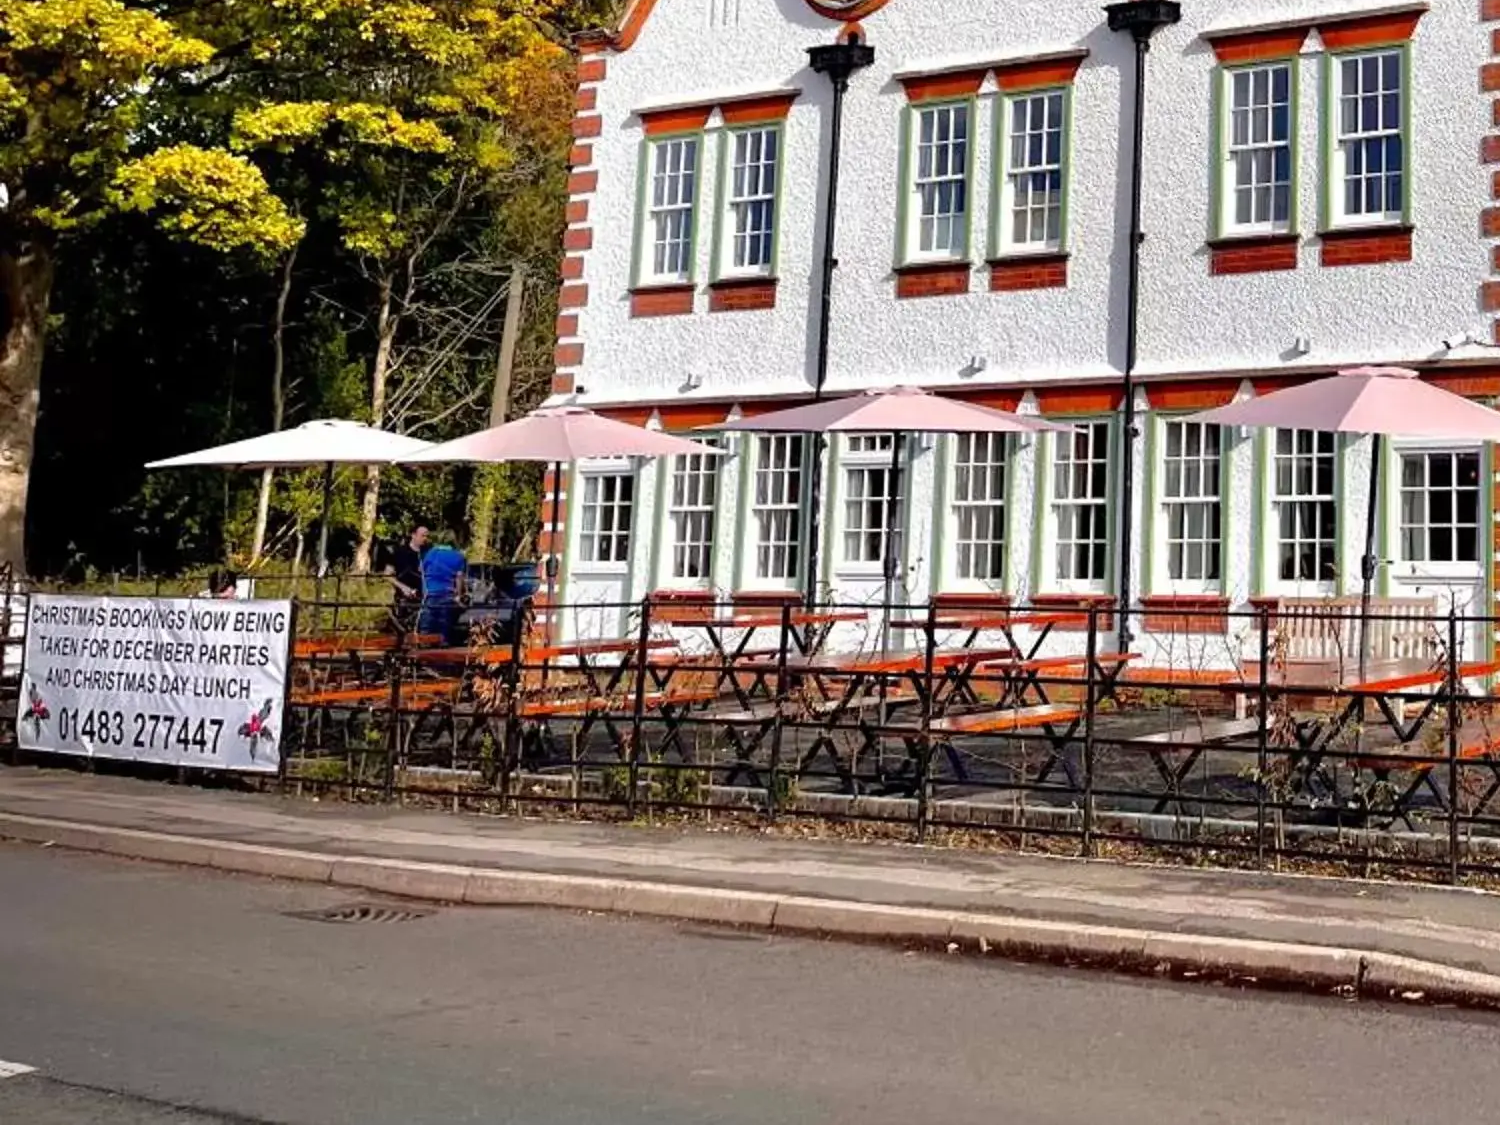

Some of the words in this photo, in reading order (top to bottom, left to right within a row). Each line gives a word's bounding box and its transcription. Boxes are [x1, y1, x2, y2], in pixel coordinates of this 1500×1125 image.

[32, 605, 105, 626] CHRISTMAS
[110, 608, 186, 630] BOOKINGS
[190, 611, 231, 632] NOW
[233, 612, 285, 633] BEING
[40, 636, 78, 656] TAKEN
[82, 639, 109, 659] FOR
[113, 641, 194, 663] DECEMBER
[199, 644, 269, 666] PARTIES
[46, 668, 71, 687] AND
[73, 670, 155, 693] CHRISTMAS
[159, 677, 190, 696] DAY
[193, 678, 250, 699] LUNCH
[59, 707, 124, 745] 01483
[133, 712, 224, 754] 277447
